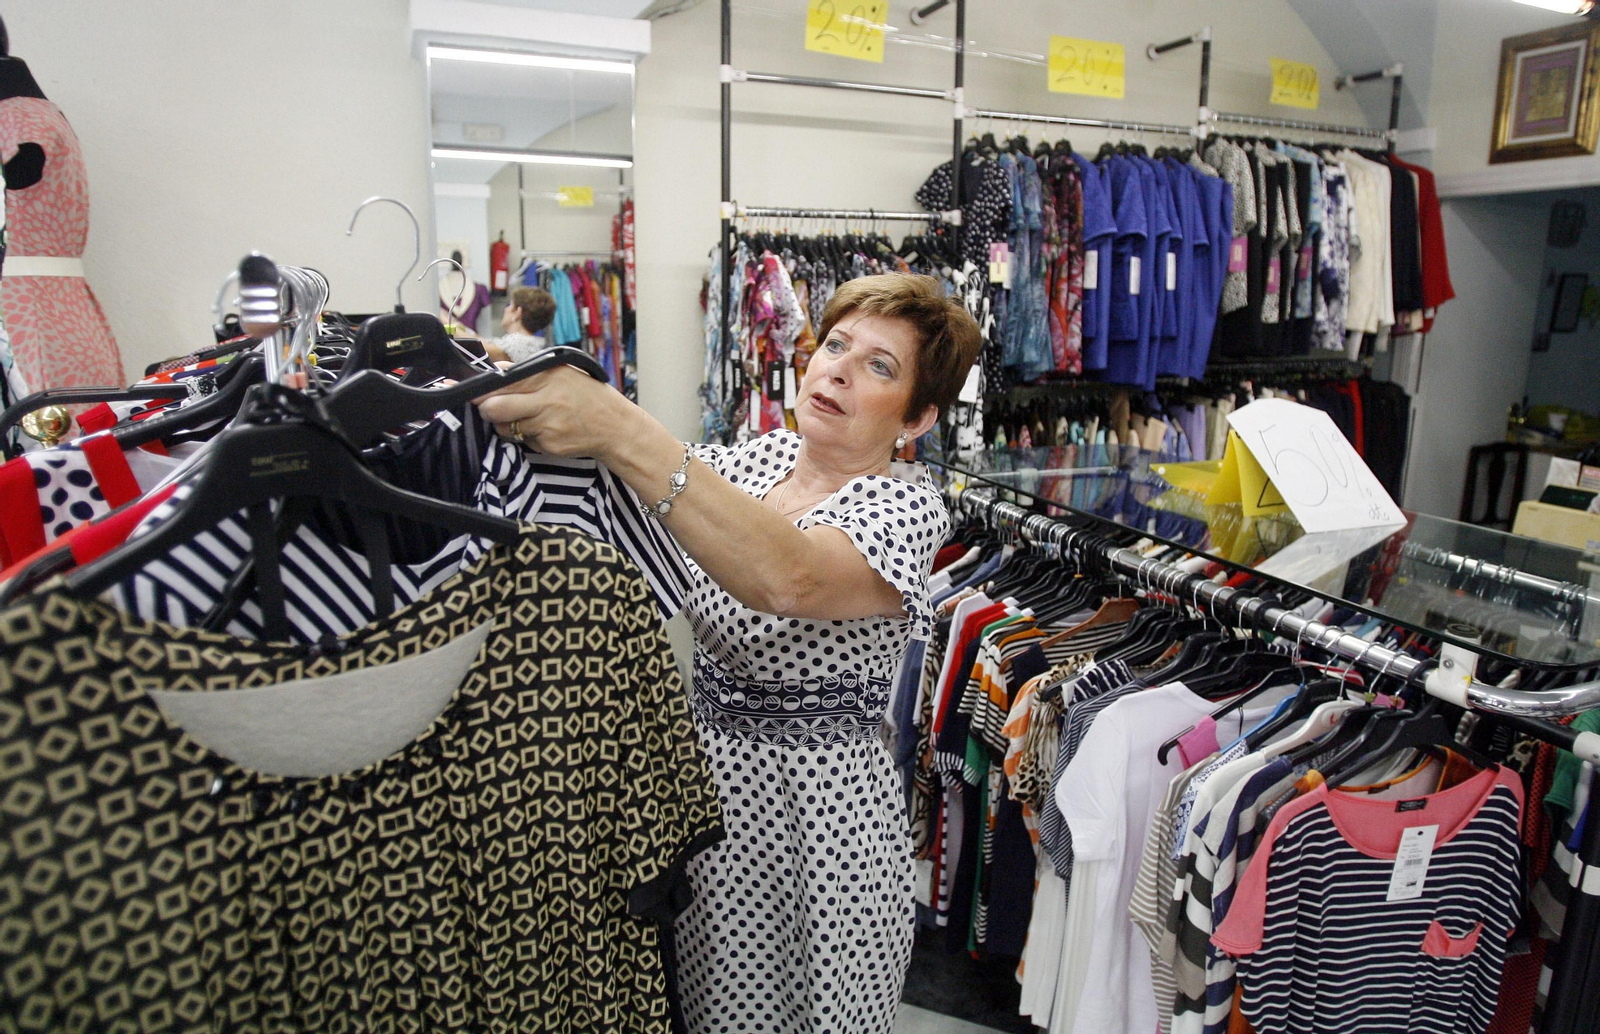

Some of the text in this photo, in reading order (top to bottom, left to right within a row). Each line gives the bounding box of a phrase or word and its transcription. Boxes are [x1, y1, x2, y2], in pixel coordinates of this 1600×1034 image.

[814, 0, 886, 52] 20%
[1055, 45, 1115, 90] 20%
[1258, 423, 1373, 508] 50%
